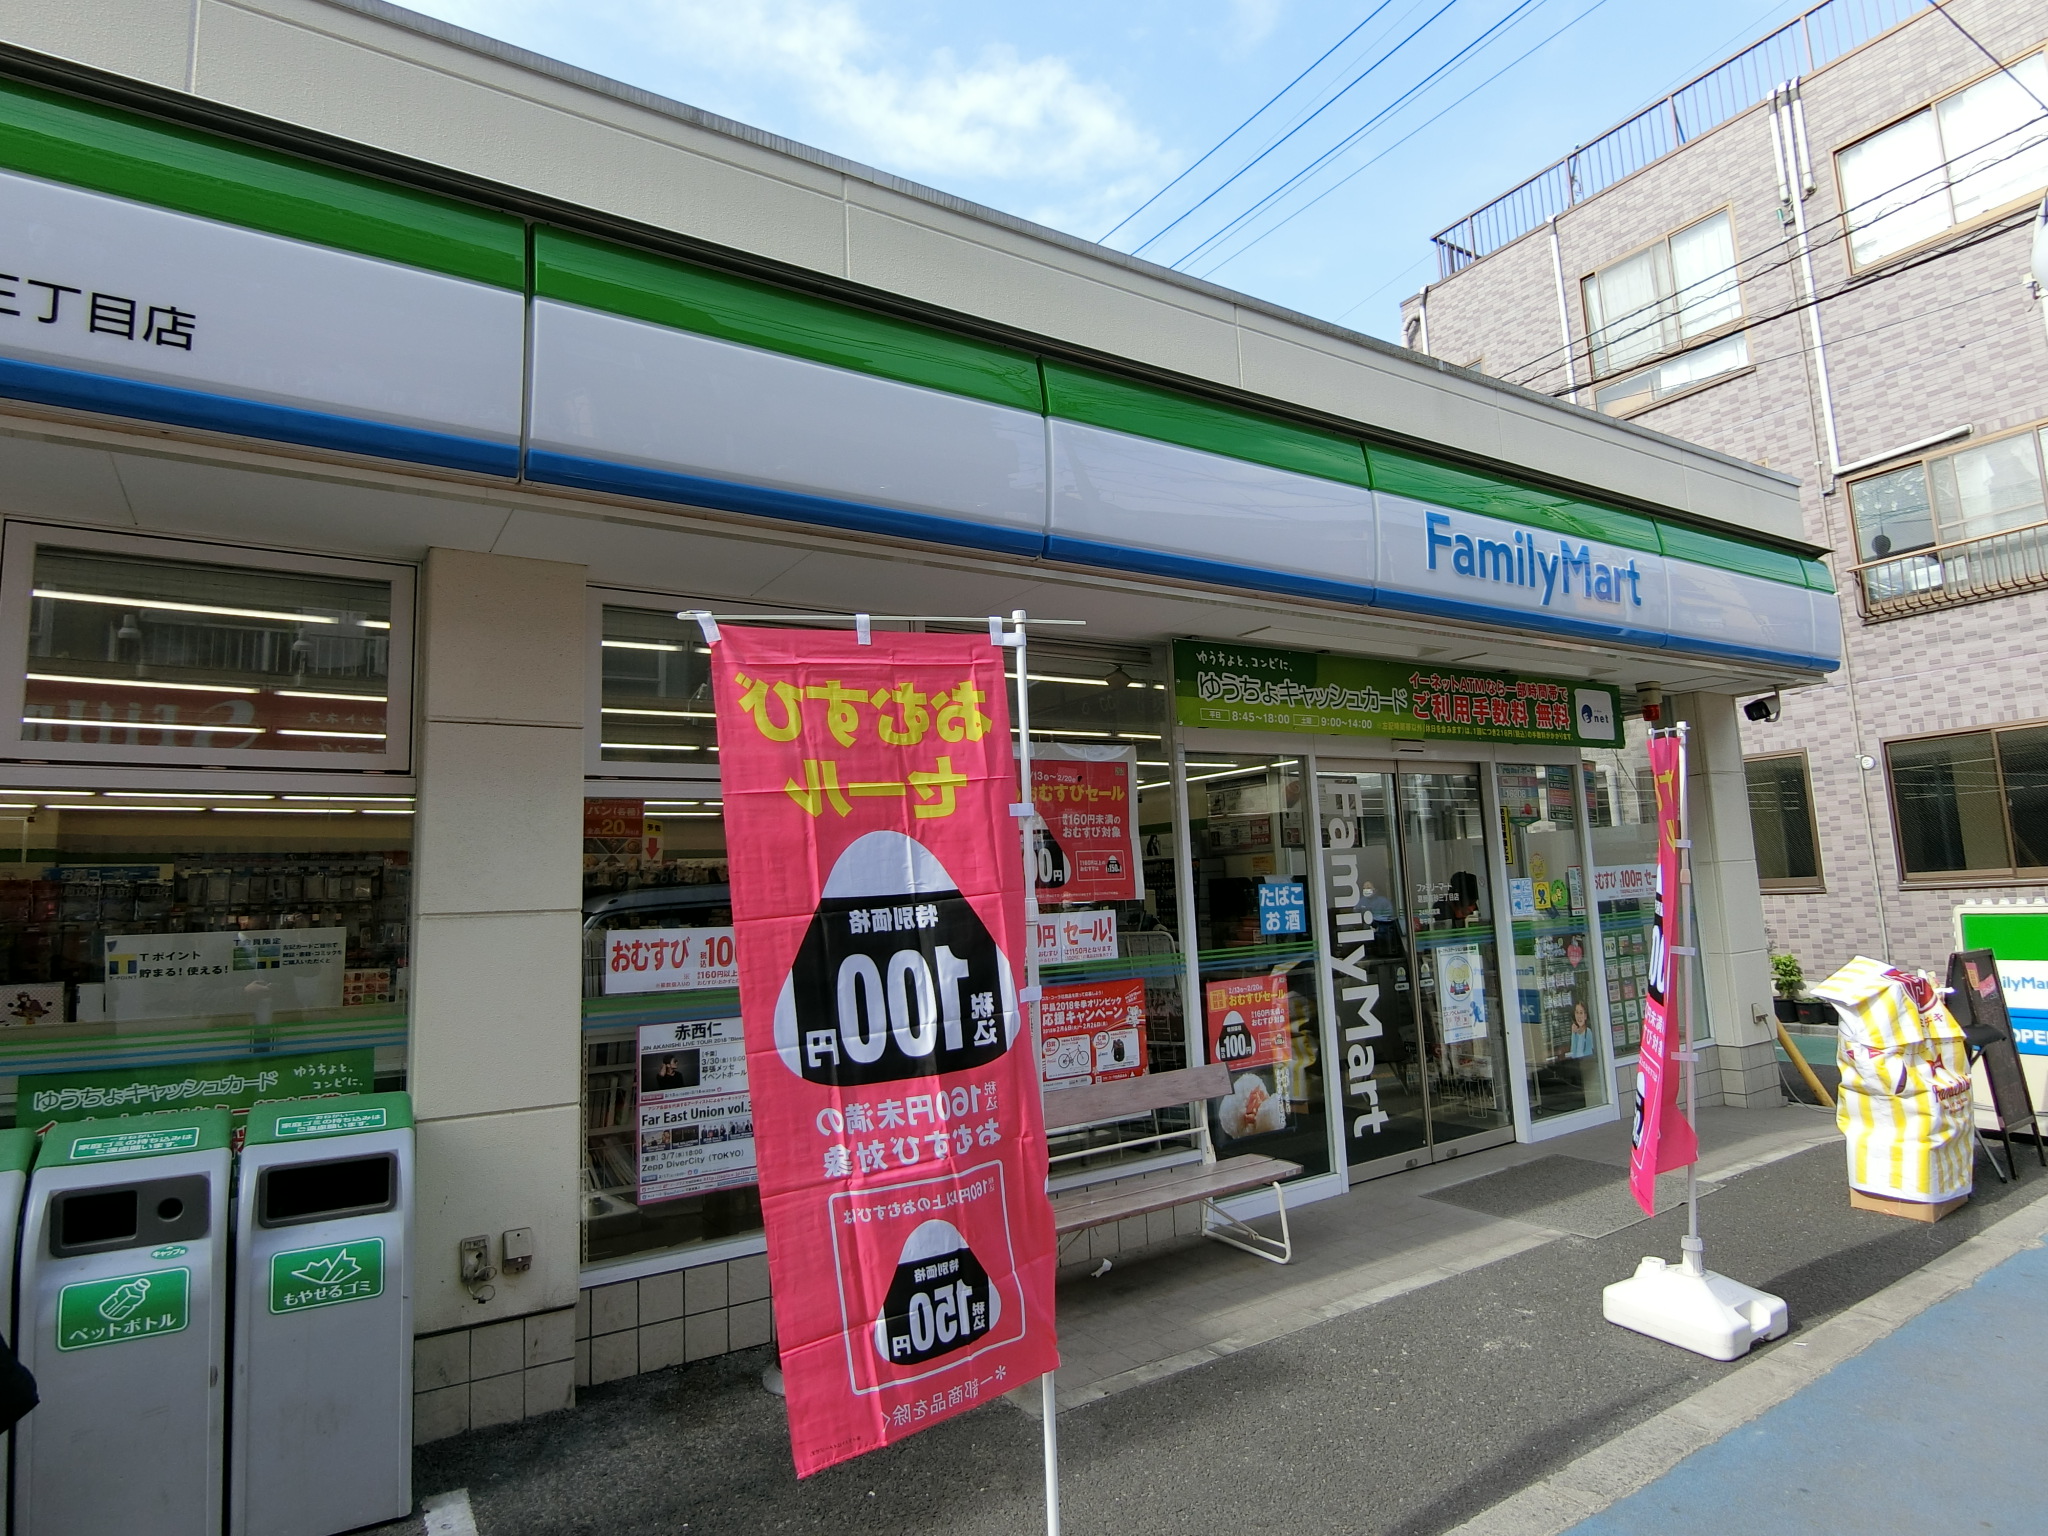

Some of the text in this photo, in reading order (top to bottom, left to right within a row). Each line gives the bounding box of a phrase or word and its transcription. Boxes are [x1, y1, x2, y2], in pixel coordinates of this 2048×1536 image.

[1423, 509, 1642, 607] FamilyMart
[1197, 671, 1408, 715] ゆうちょキャッシュカード
[1408, 671, 1568, 701] イーネットATMなら一部時間帯で
[1412, 693, 1571, 731] ご利用手数料 無料
[602, 819, 626, 835] 20
[1062, 825, 1122, 838] おむすび対象
[1259, 886, 1304, 907] たばこ
[1063, 917, 1113, 946] セール!
[1265, 911, 1301, 931] お酒
[611, 936, 691, 972] おむすび
[705, 935, 738, 967] 10
[1324, 783, 1390, 1138] FamilyMart
[2002, 976, 2048, 992] ilyMa
[1042, 996, 1122, 1012] 平昌2018冬季オリンピック
[1228, 989, 1286, 1006] おむすびセール
[1042, 1007, 1123, 1027] 応援キャンペーン
[675, 1021, 723, 1041] 赤西仁
[653, 1042, 681, 1050] AKANISHI
[701, 1063, 735, 1073] 幕張メッセ
[702, 1070, 747, 1081] イベントホール
[33, 1070, 279, 1112] ゆうちょキャッシュカード
[641, 1114, 661, 1126] Far
[664, 1110, 688, 1124] East
[691, 1105, 725, 1120] Union
[641, 1149, 745, 1172] Zepp DiverCity (TOKYO)
[284, 1280, 372, 1308] もやせるゴミ
[69, 1313, 177, 1342] ペットボトル
